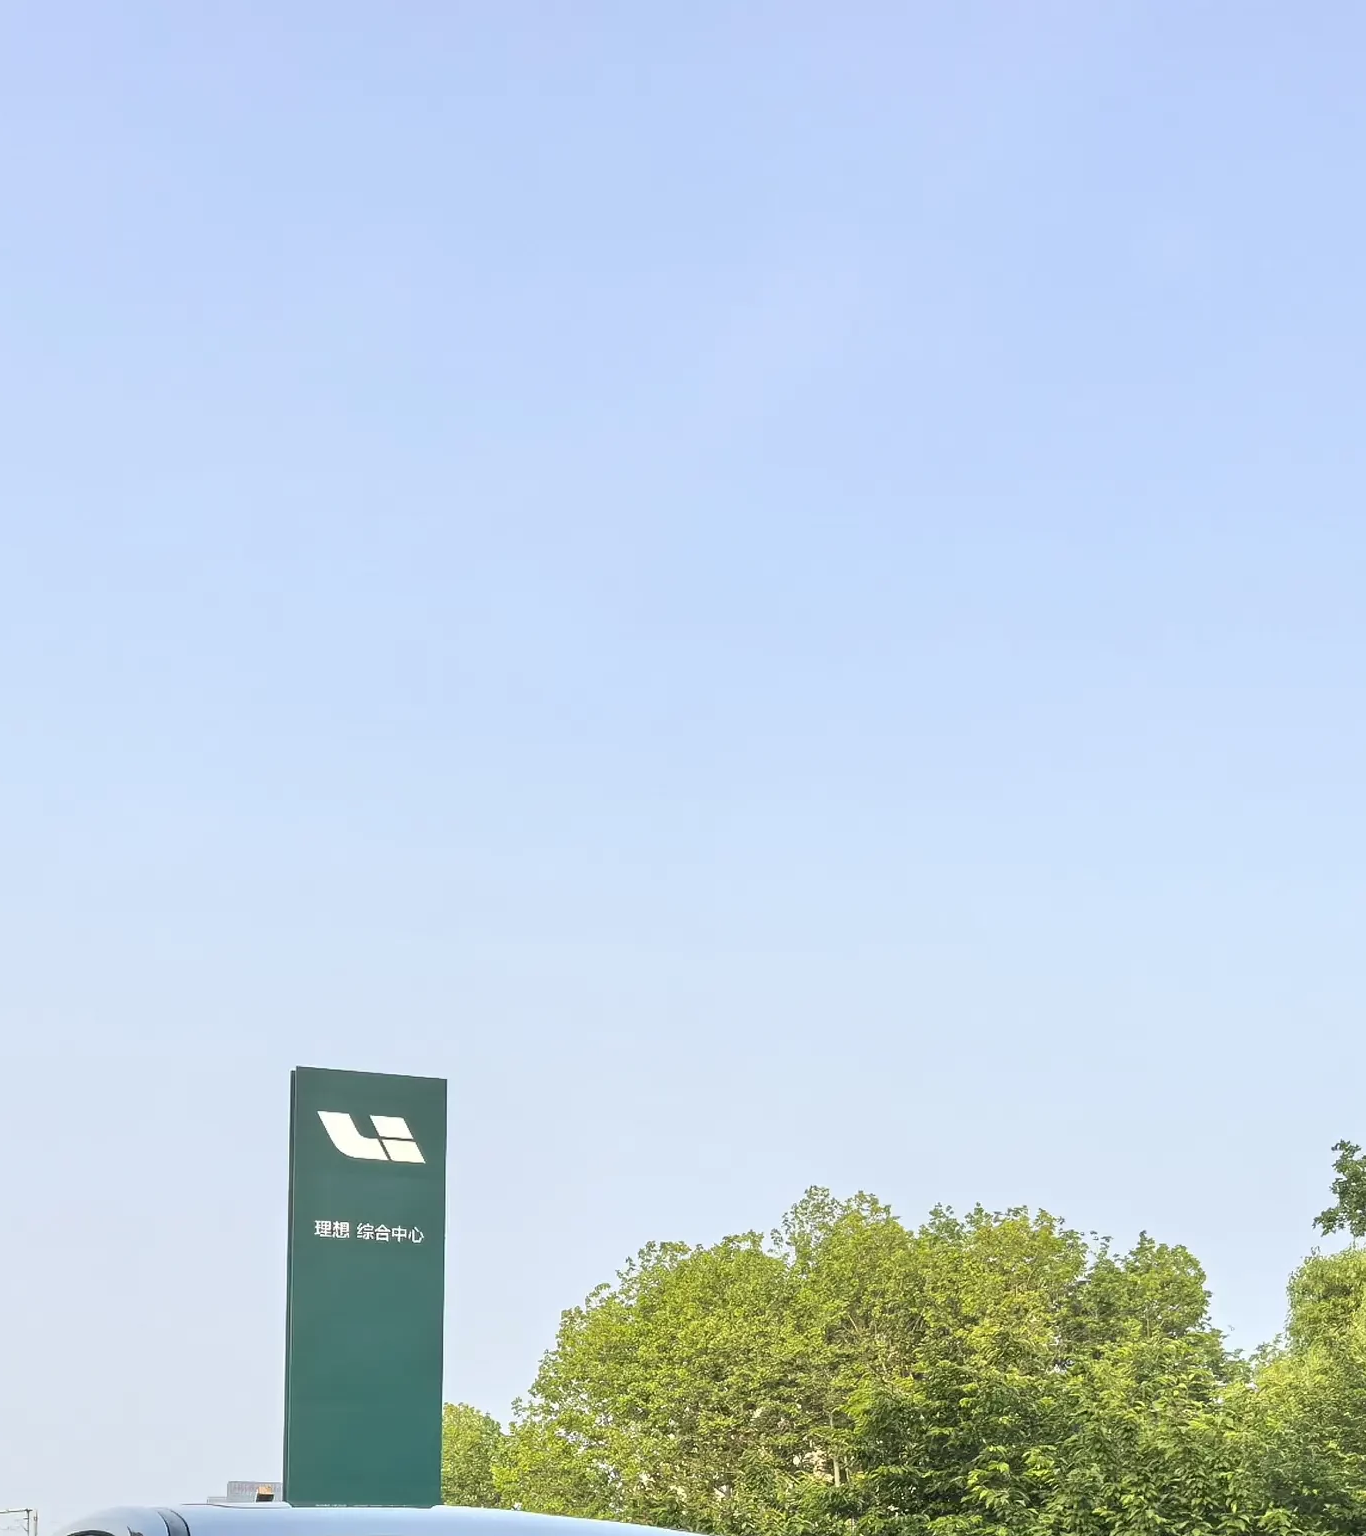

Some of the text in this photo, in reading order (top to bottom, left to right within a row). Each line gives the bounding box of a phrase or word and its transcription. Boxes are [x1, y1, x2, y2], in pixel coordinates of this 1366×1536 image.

[314, 1220, 425, 1244] 理想 综合中心
